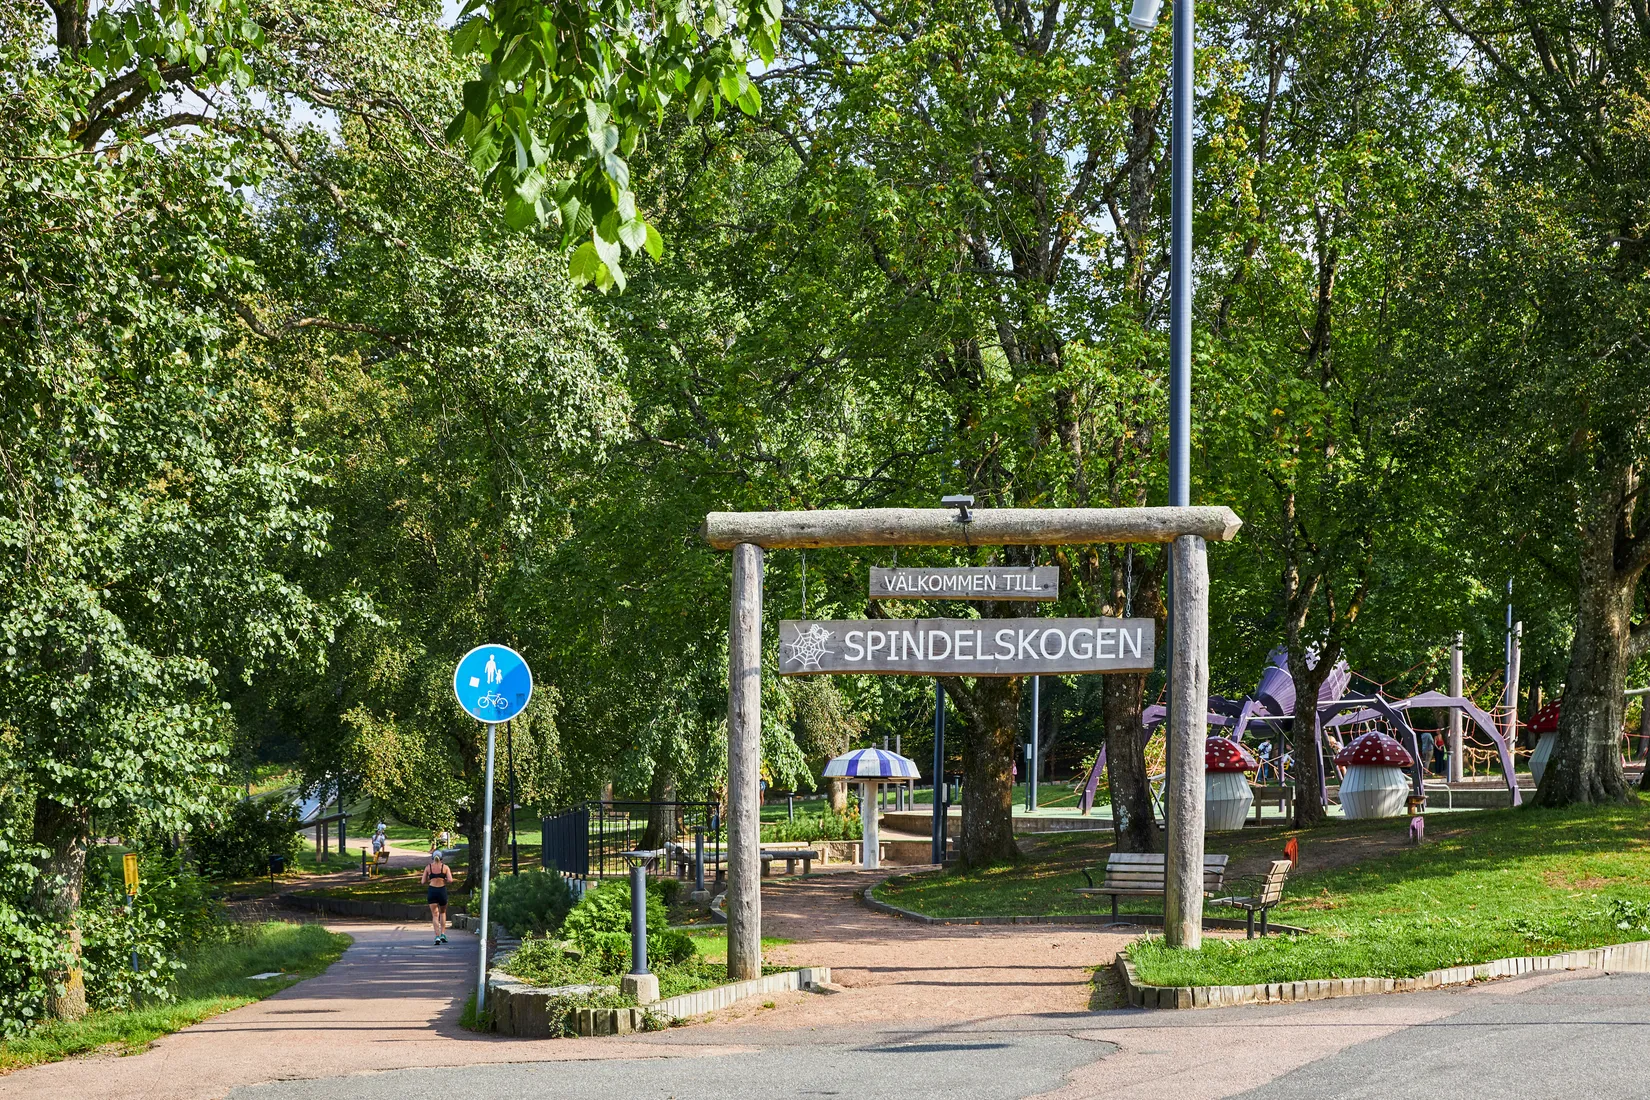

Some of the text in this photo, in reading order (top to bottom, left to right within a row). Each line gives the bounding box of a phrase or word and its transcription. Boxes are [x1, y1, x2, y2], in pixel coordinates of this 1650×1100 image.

[884, 573, 1042, 592] VÄLKOMMEN TILL
[843, 627, 1143, 661] SPINDELSKOGEN
